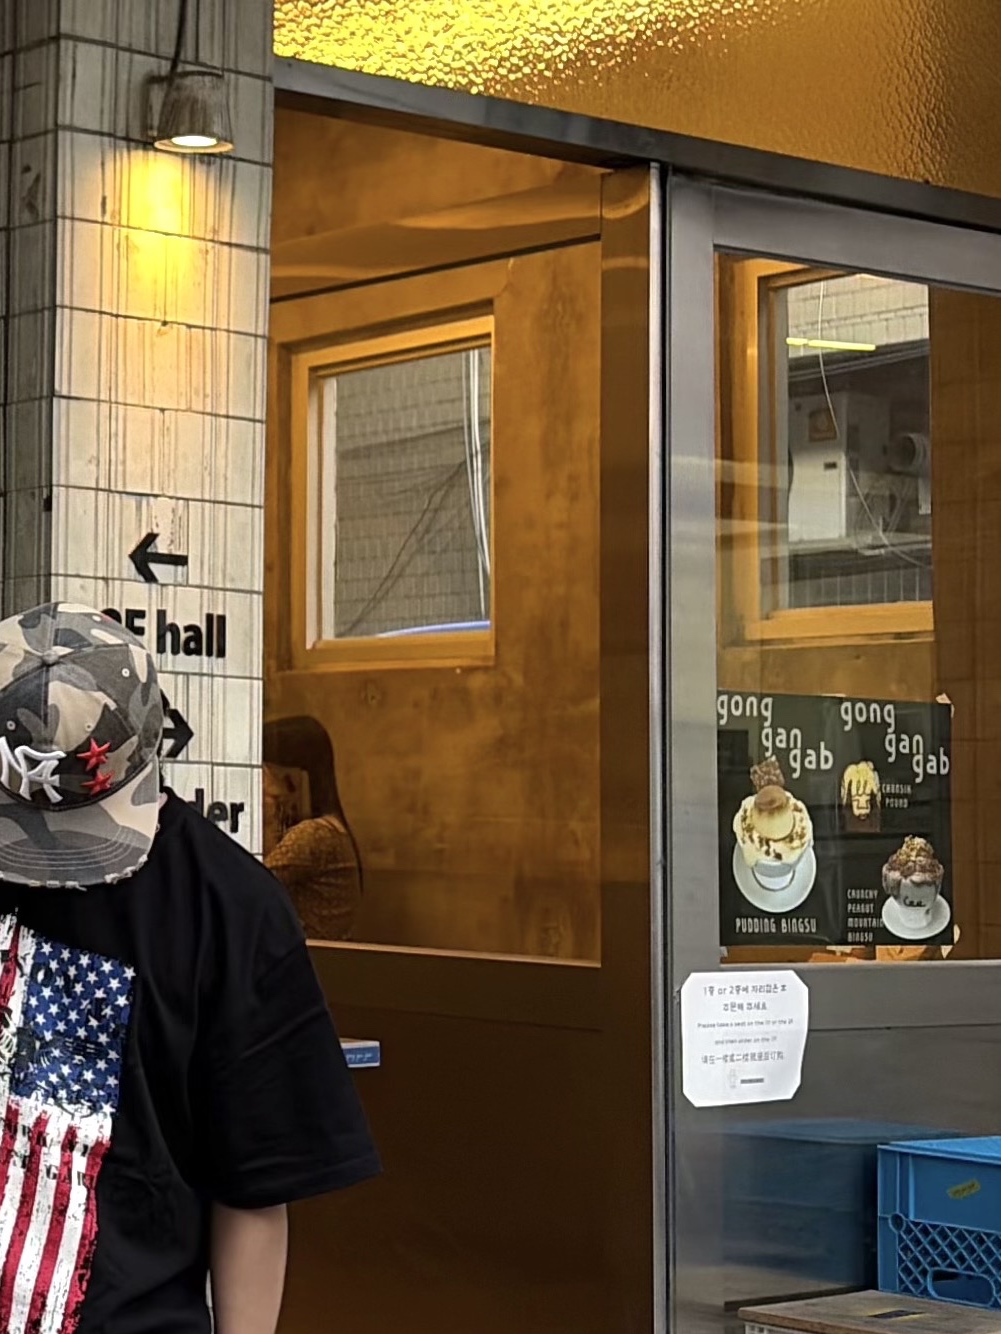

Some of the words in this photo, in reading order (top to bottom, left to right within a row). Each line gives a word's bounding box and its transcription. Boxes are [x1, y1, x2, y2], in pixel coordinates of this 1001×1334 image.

[156, 609, 227, 659] hall
[717, 694, 773, 726] gong
[840, 701, 895, 734] gong
[761, 726, 802, 757] gan
[884, 733, 924, 763] gan
[789, 741, 834, 779] gab
[912, 747, 950, 783] gab
[885, 797, 909, 809] POUND
[847, 888, 879, 900] CRUNCHY
[847, 903, 875, 914] PEANUT
[735, 917, 777, 934] PUDDING
[781, 917, 818, 934] BINGSU
[847, 931, 874, 943] BINGSU
